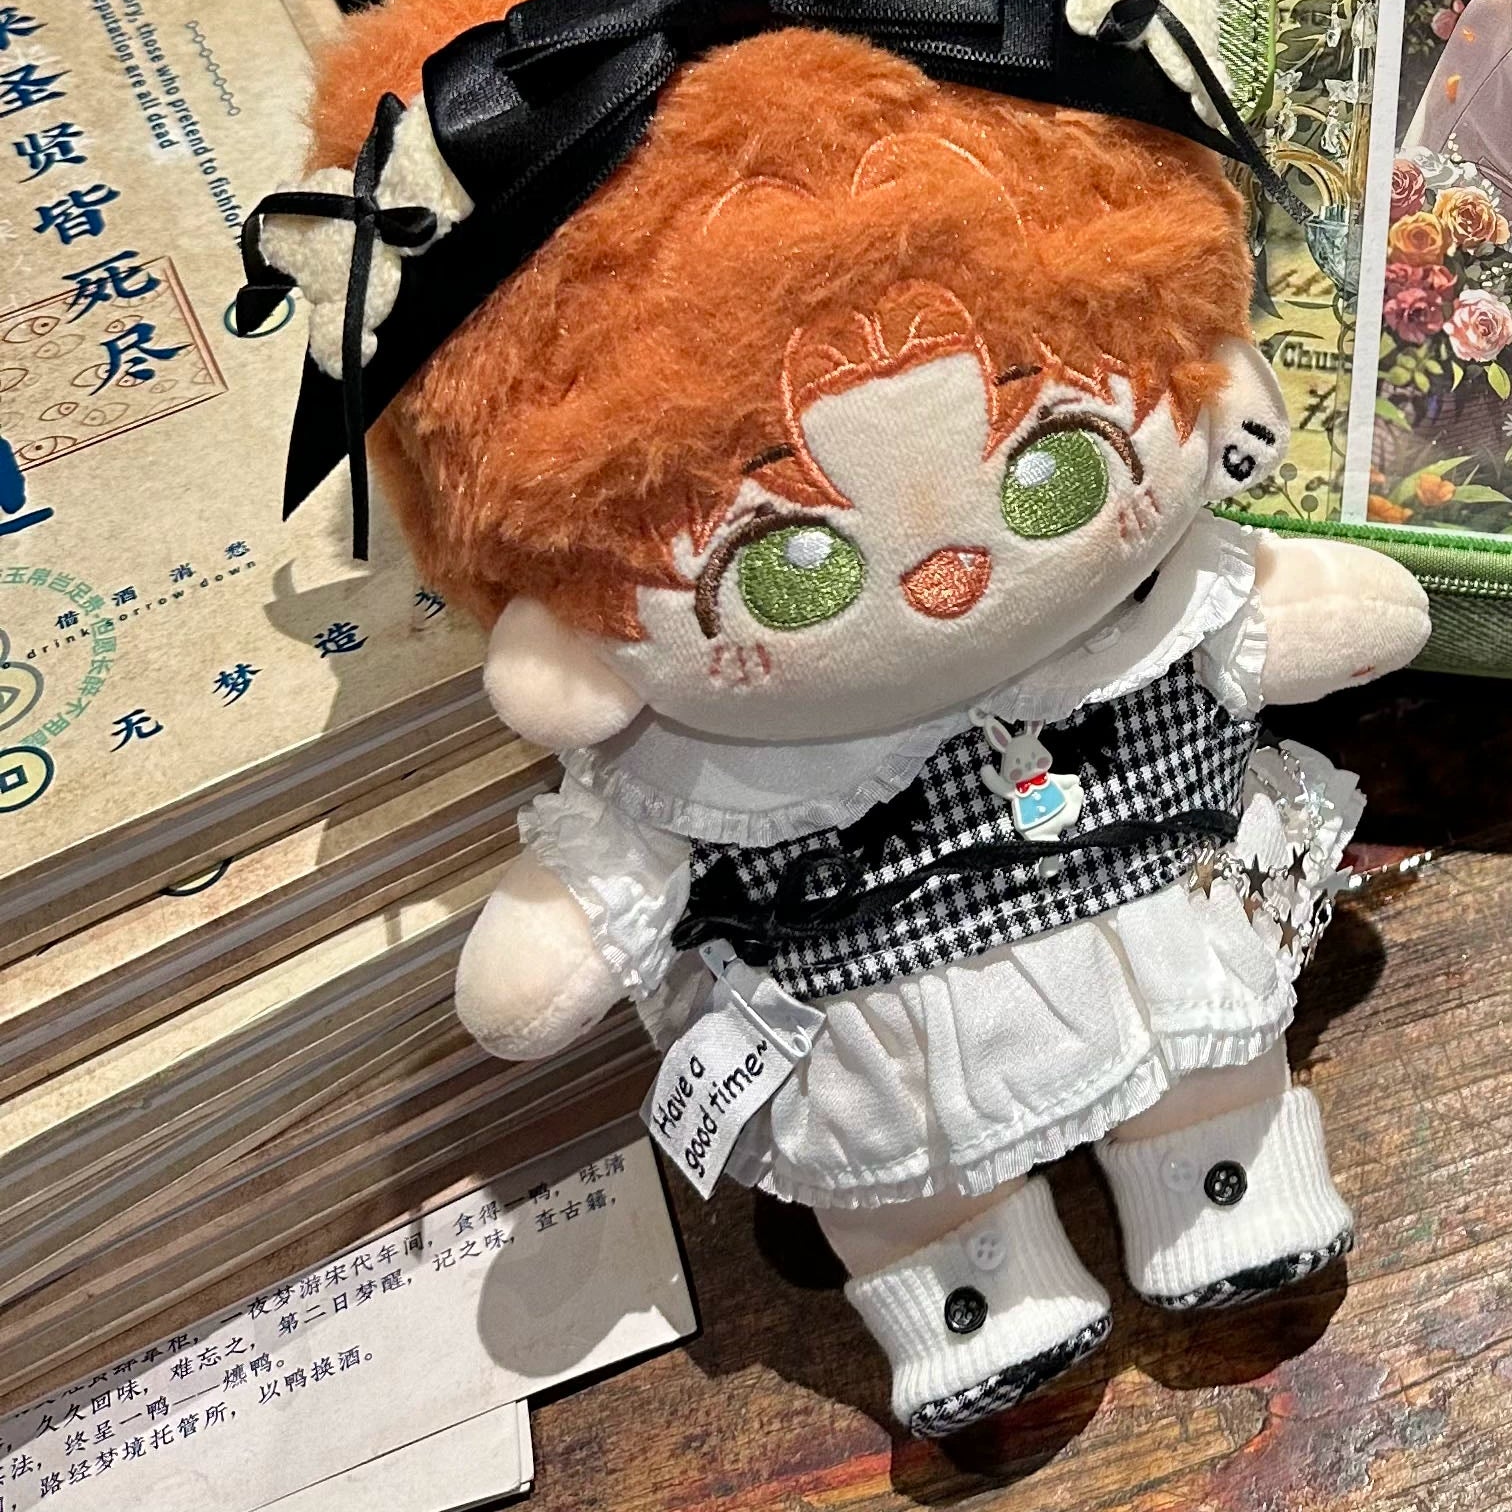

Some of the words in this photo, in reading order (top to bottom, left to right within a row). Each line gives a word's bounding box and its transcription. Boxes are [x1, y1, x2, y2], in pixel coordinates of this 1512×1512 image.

[136, 22, 165, 63] those
[125, 64, 147, 89] are
[156, 64, 180, 95] who
[136, 90, 162, 111] all
[147, 112, 180, 149] dead
[166, 98, 215, 156] pretend
[199, 157, 217, 175] to
[55, 541, 250, 629] 借酒消愁
[27, 628, 90, 659] drink
[104, 590, 184, 628] sorrow
[200, 560, 256, 588] down
[653, 1076, 693, 1138] Have
[690, 1055, 706, 1078] a
[685, 1104, 718, 1178] good
